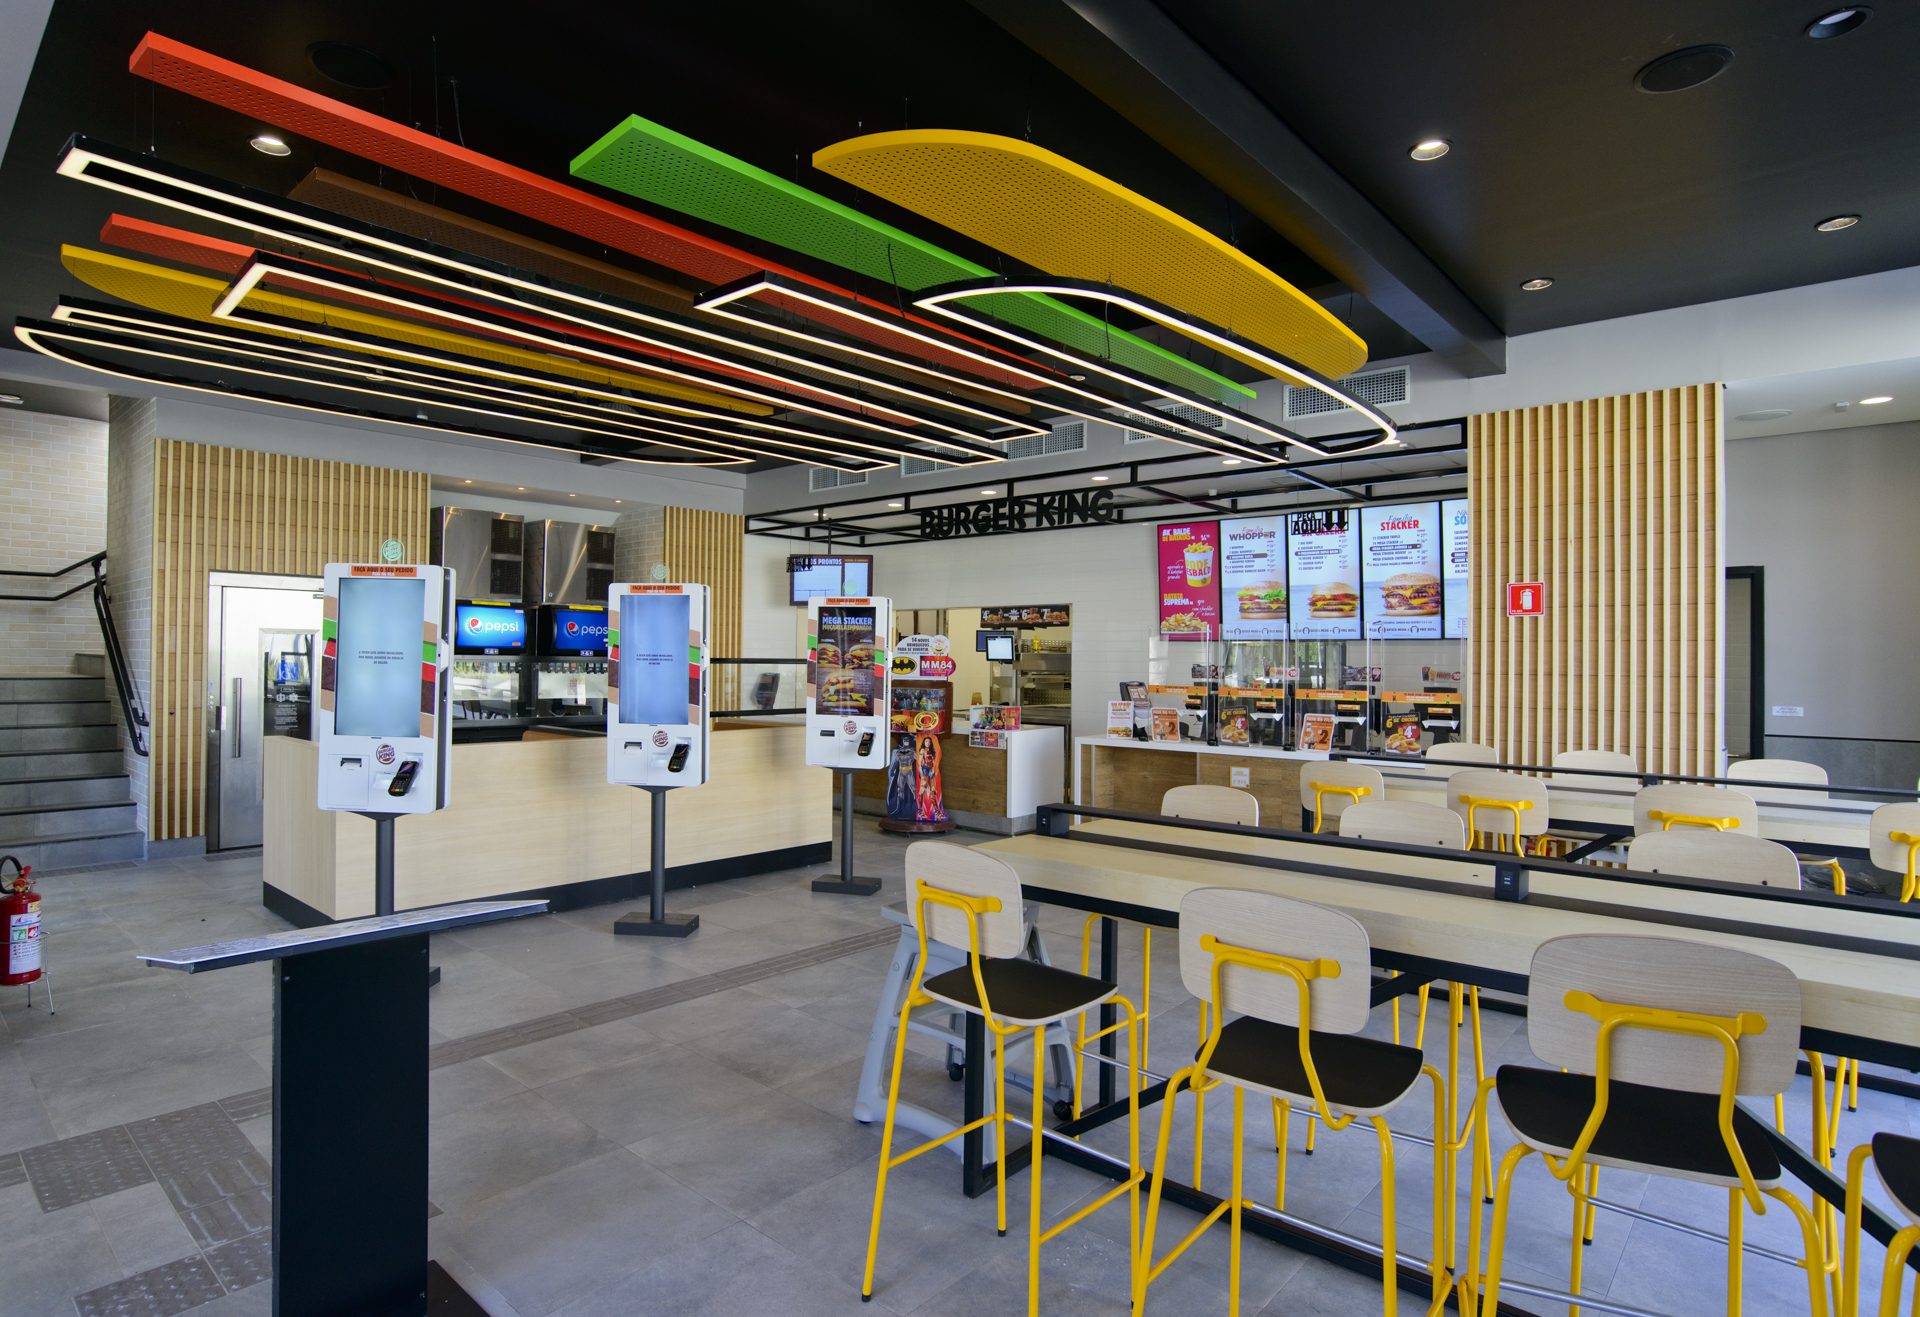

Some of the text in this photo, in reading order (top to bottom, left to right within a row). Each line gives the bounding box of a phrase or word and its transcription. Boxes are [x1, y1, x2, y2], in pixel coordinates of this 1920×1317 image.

[921, 490, 1114, 539] BURGER KING
[1380, 520, 1420, 531] STACKER
[1229, 531, 1276, 541] WHOPPER
[822, 616, 872, 625] MEGA STACKER
[486, 621, 519, 633] pepsi
[581, 625, 609, 636] peps
[921, 660, 953, 669] MM84
[379, 751, 395, 760] KING
